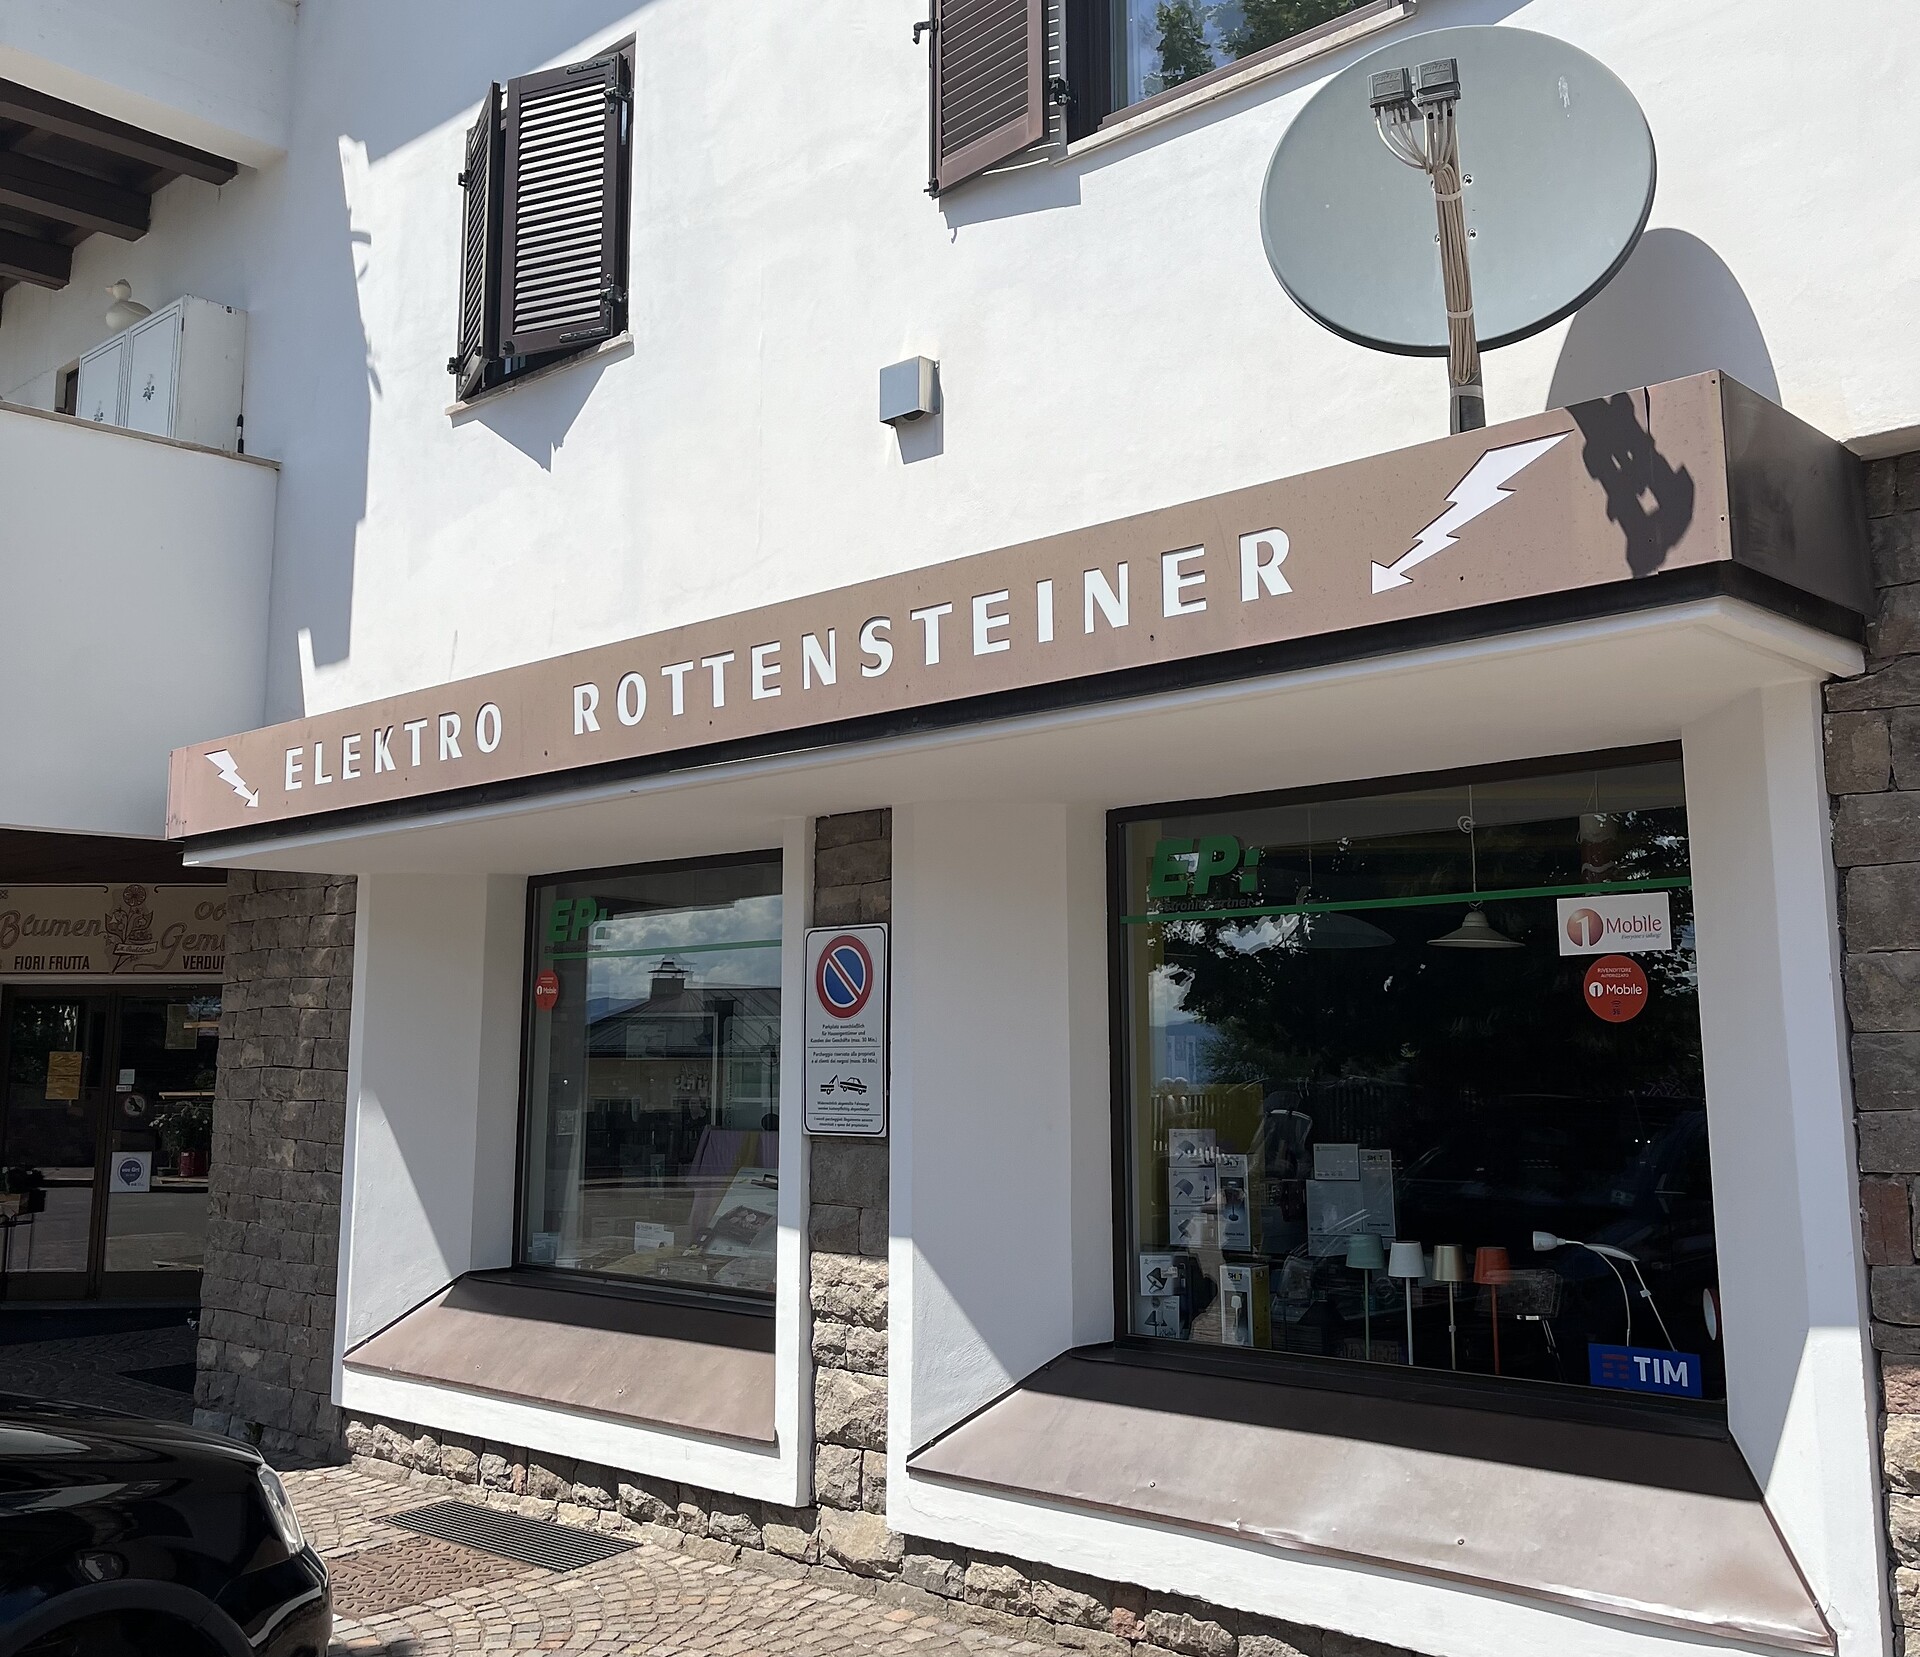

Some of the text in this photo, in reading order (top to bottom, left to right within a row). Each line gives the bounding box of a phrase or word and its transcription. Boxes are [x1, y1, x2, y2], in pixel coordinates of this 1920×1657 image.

[284, 526, 1293, 790] ELEKTRO ROTTENSTEINER
[0, 910, 106, 950] Blumen
[14, 955, 90, 970] FIORI FRUTTA
[1606, 983, 1643, 995] Mobile
[1633, 1356, 1688, 1387] TIM
